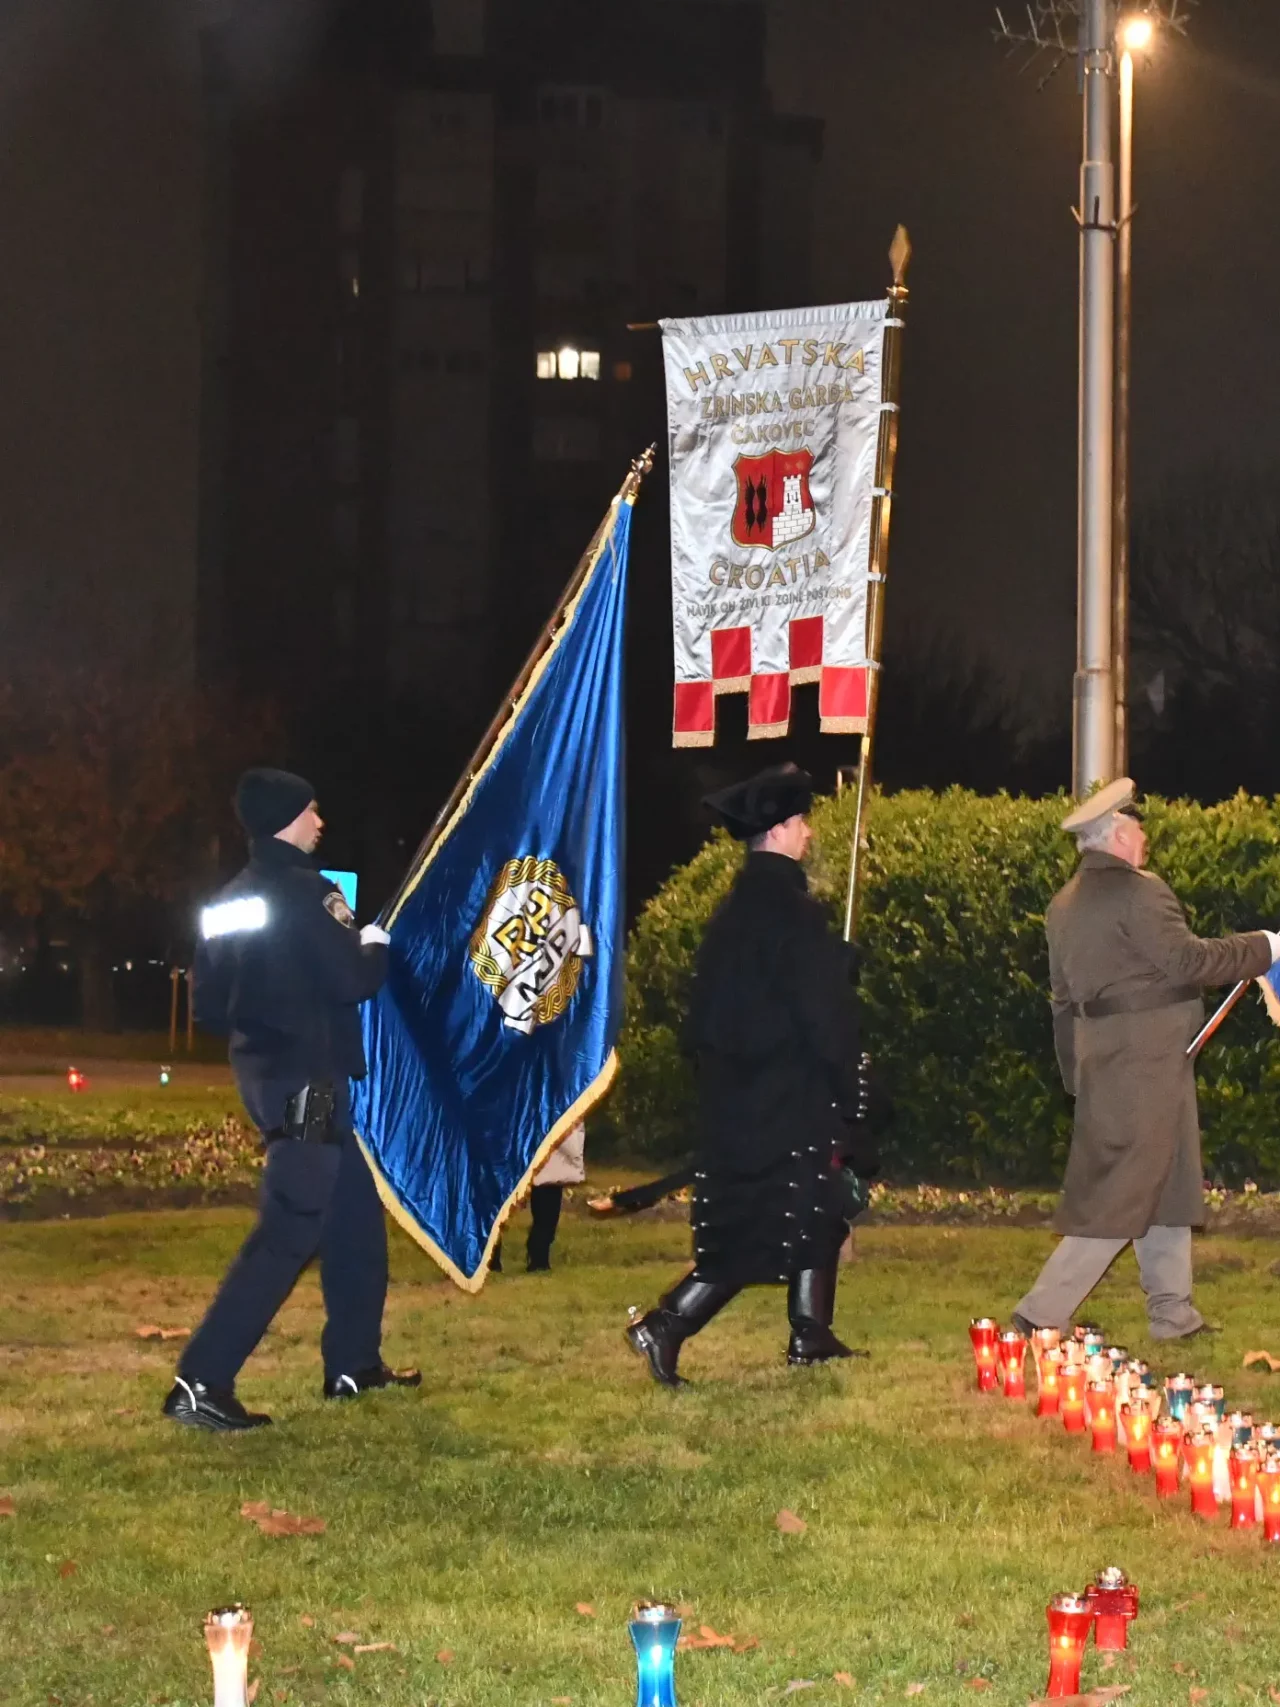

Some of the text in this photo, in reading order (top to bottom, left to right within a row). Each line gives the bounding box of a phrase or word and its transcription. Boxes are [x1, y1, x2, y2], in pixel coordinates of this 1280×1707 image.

[682, 339, 865, 391] HRVATSKA
[700, 383, 854, 419] ZRINSKA GARDA
[730, 419, 816, 445] ČAKOVEC
[708, 547, 831, 591] CROATIA
[491, 886, 552, 970] RH
